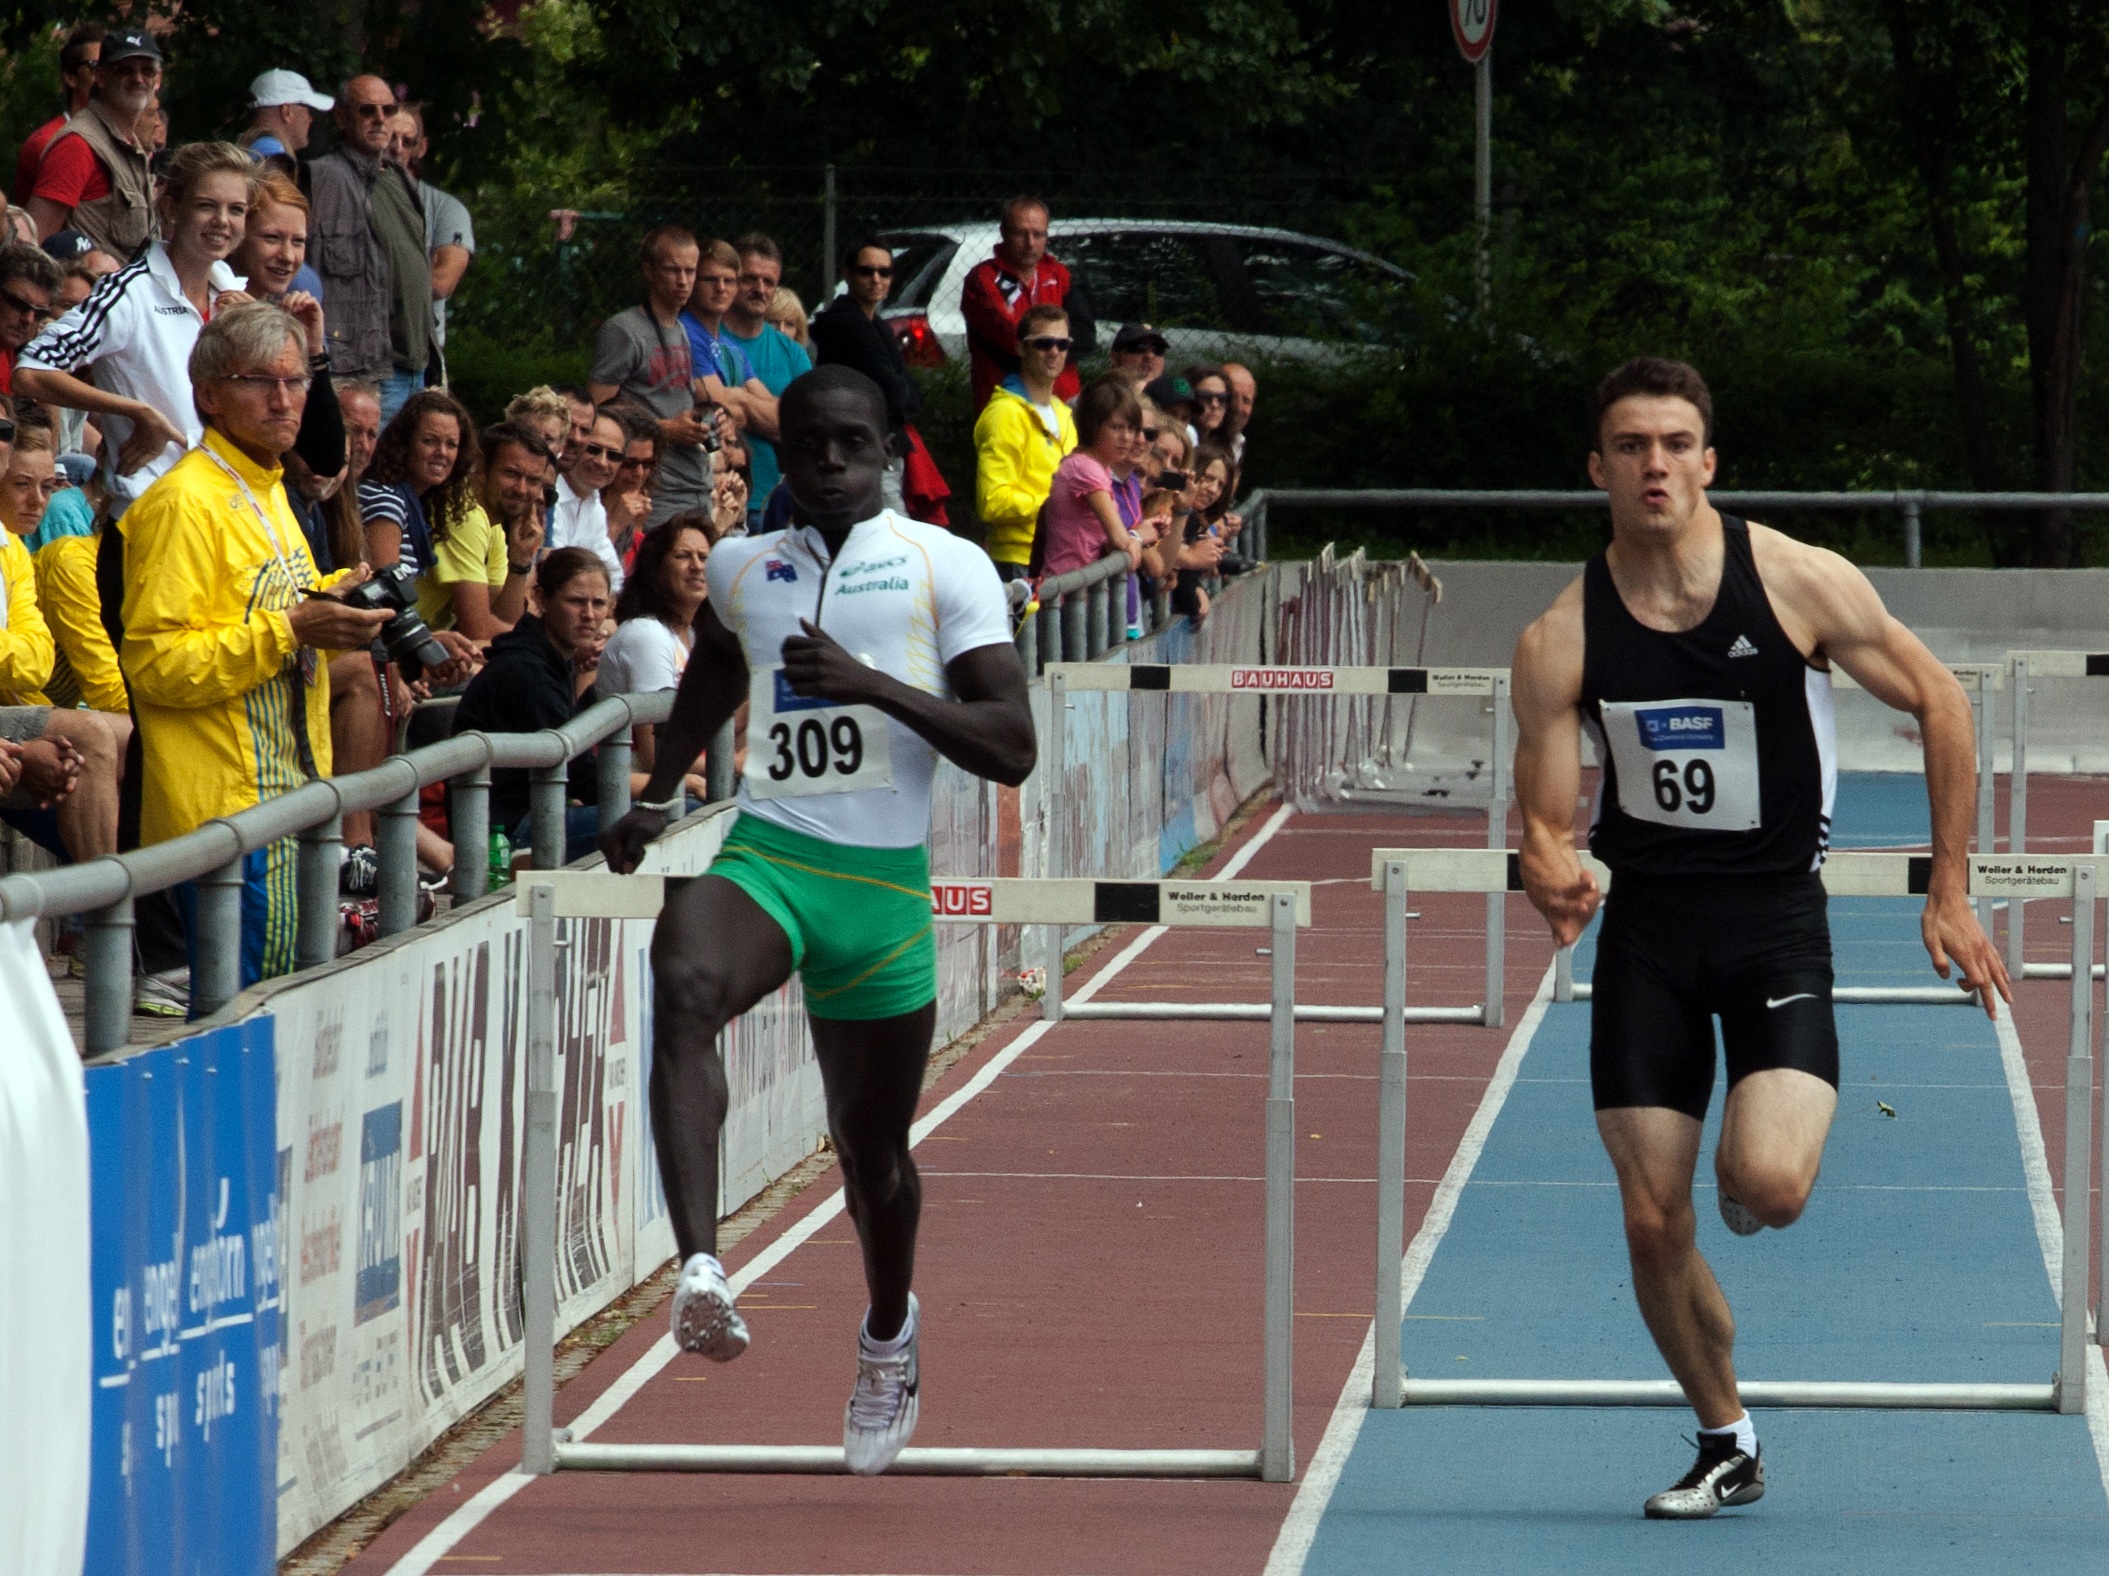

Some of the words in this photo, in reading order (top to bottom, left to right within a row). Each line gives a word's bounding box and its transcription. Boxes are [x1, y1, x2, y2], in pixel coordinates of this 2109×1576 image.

[834, 576, 909, 596] Australia
[1232, 671, 1333, 688] BAUHAUS
[1669, 716, 1714, 731] BASF
[768, 715, 863, 781] 309
[1652, 758, 1716, 815] 69
[1977, 865, 2012, 874] Weller
[2014, 865, 2023, 874] &
[2027, 865, 2068, 874] Herden
[1984, 876, 2060, 886] Sportgerätebau
[1167, 891, 1206, 901] Weller
[1209, 892, 1218, 901] &
[1222, 891, 1265, 901] Herden
[1176, 903, 1257, 914] Sportgerätebau
